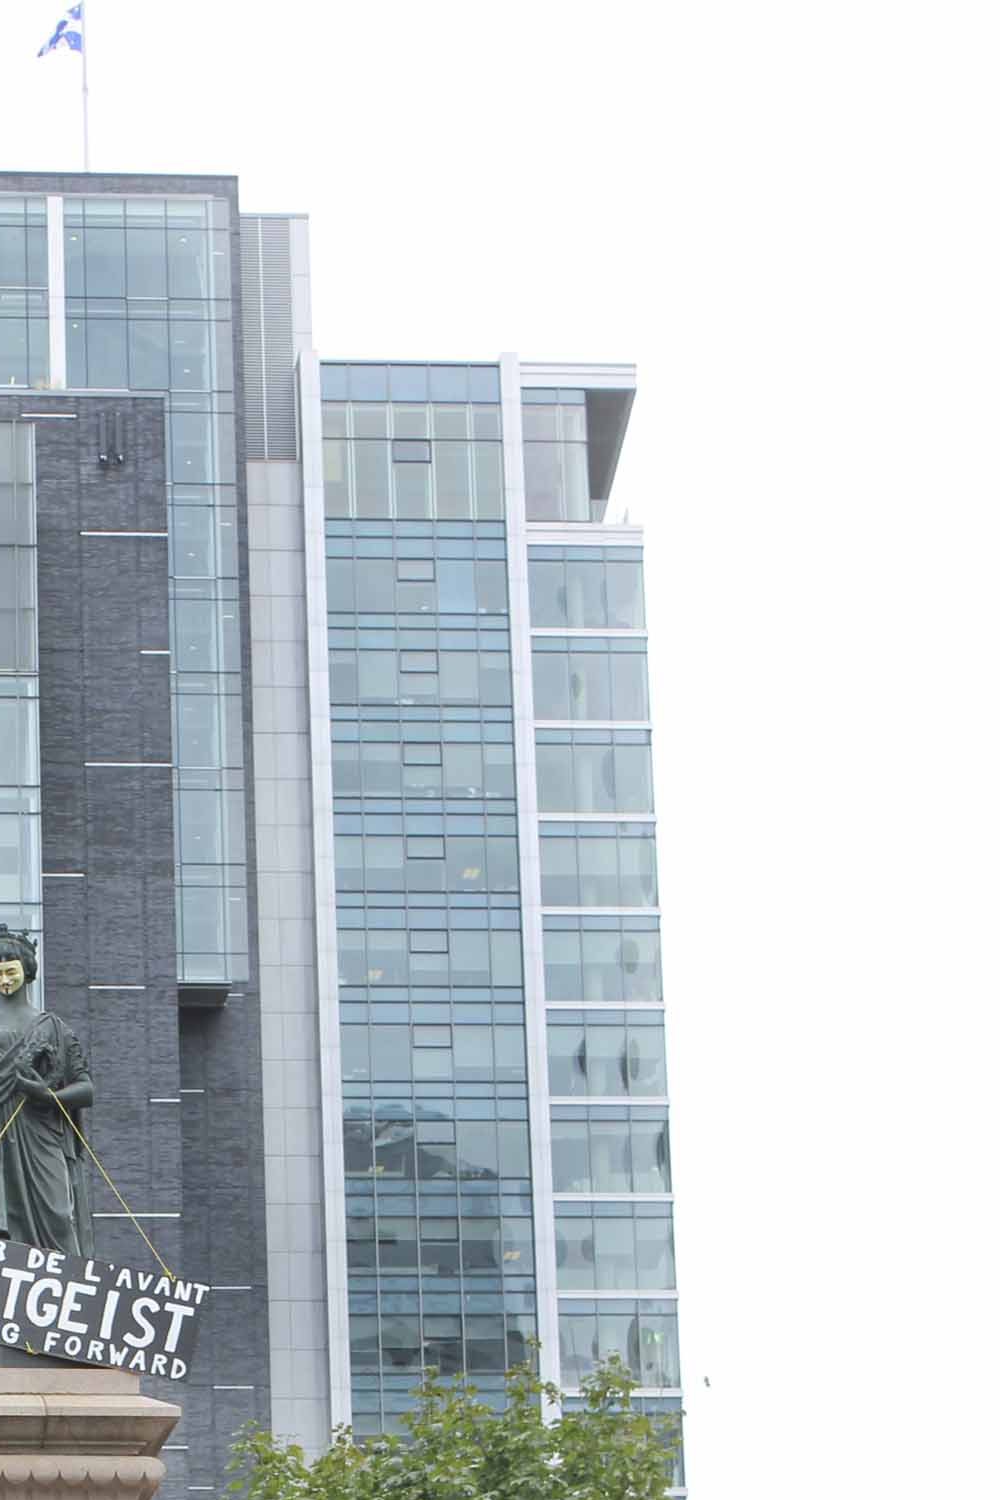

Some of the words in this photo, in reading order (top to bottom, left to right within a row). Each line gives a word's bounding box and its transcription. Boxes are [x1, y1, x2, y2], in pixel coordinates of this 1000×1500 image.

[27, 1249, 66, 1275] DE
[85, 1260, 211, 1304] L'AVANT
[44, 1331, 187, 1380] FORWARD
